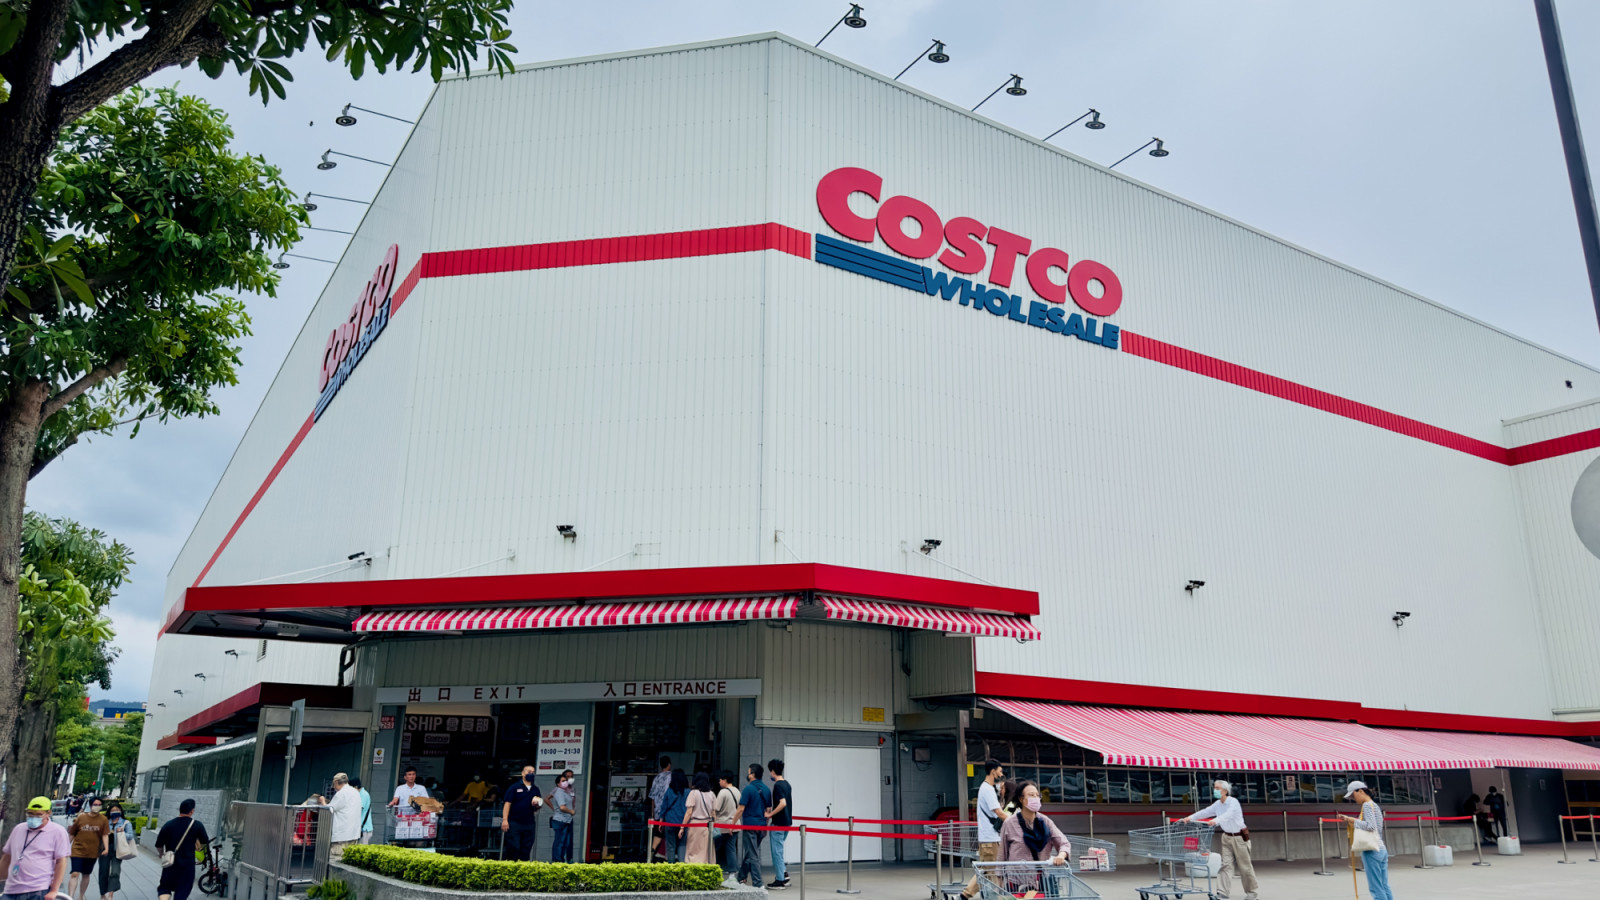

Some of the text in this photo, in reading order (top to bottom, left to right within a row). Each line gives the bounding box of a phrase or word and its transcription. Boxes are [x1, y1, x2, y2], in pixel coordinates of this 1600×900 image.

[816, 167, 1123, 317] COSTCO
[921, 266, 1120, 350] WHOLESALE
[407, 688, 452, 702] 出口
[473, 686, 526, 700] EXIT
[603, 682, 637, 697] 入口
[642, 681, 727, 696] ENTRANCE
[446, 717, 489, 732] 會員部
